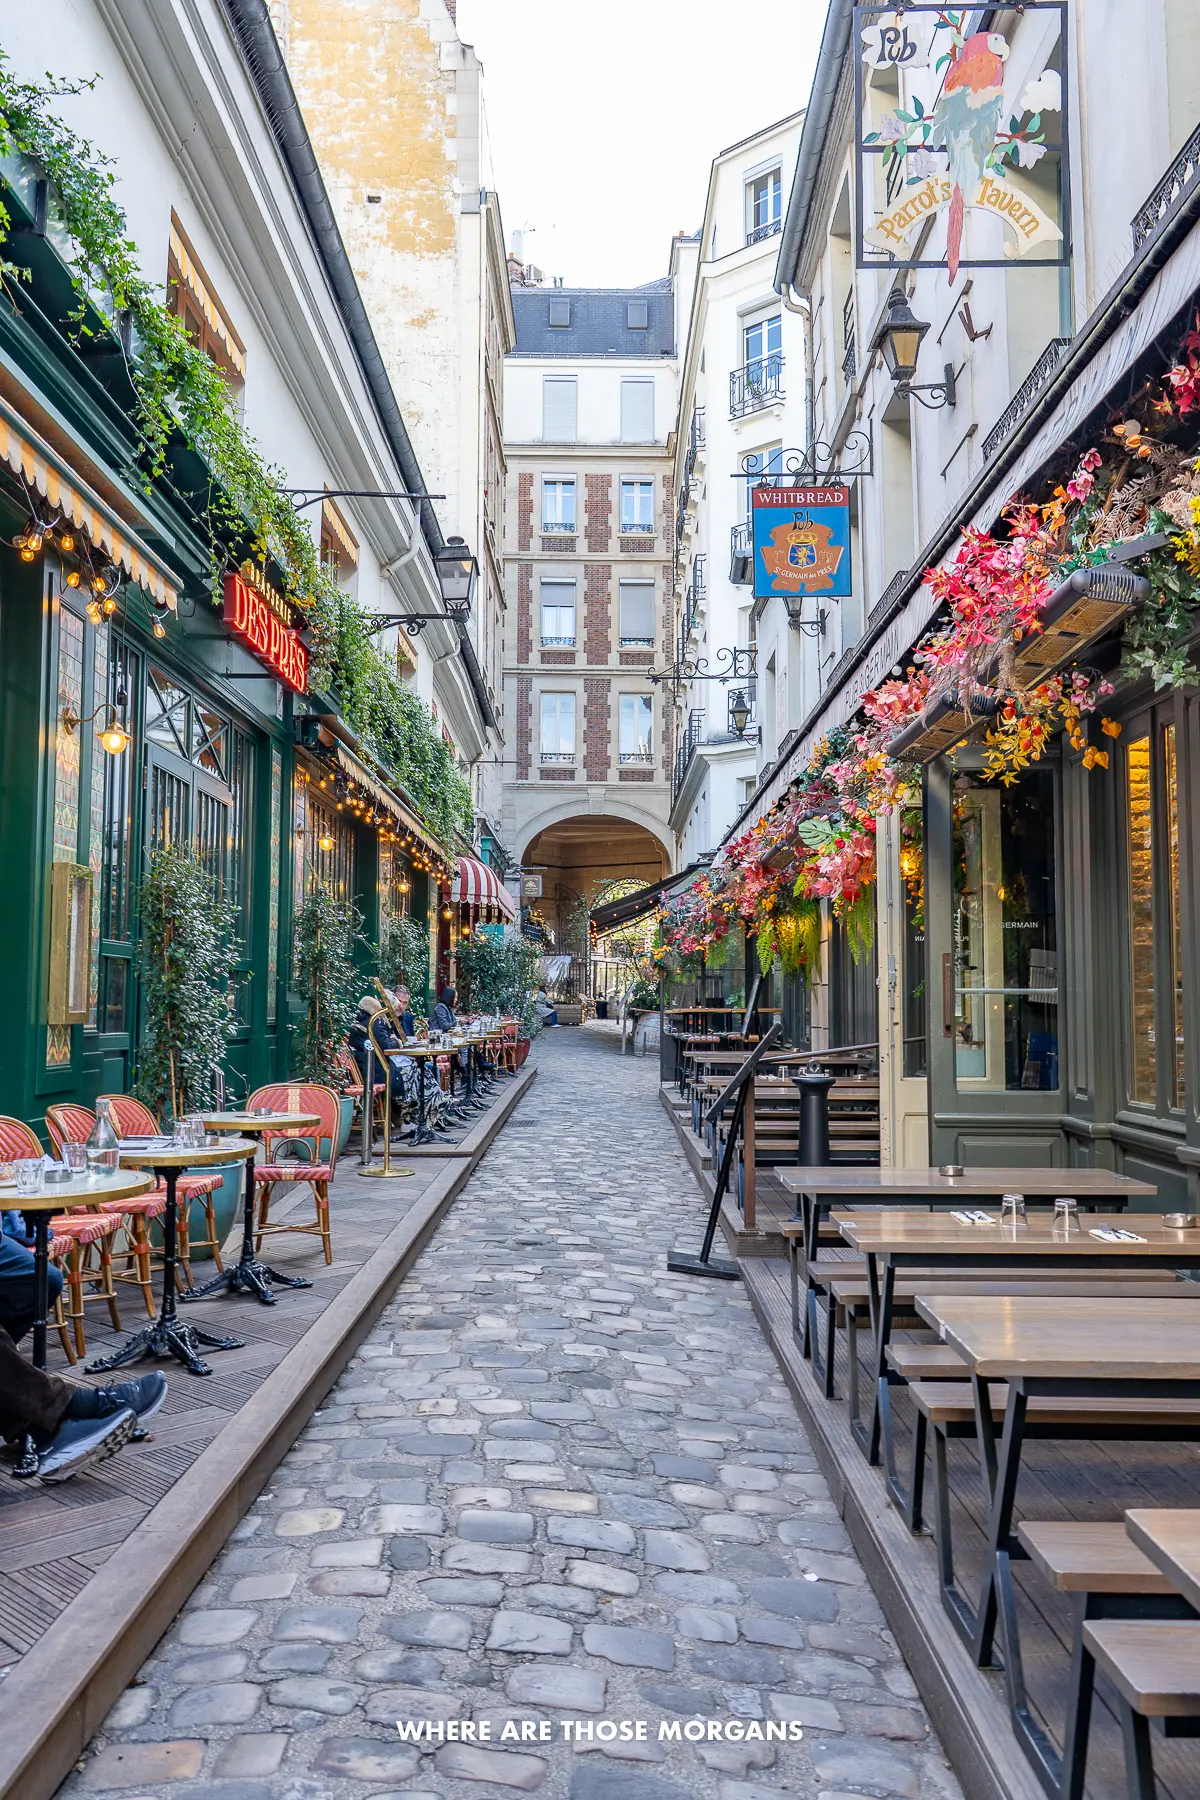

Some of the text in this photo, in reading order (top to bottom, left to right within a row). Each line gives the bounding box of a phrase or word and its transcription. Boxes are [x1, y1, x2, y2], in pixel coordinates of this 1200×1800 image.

[876, 26, 918, 65] Pub
[876, 176, 1041, 243] Parrot's Tavern
[758, 493, 844, 504] WHITBREAD
[792, 511, 814, 531] Pub
[781, 570, 809, 579] GERMAIN
[233, 577, 307, 693] DES PRÉS
